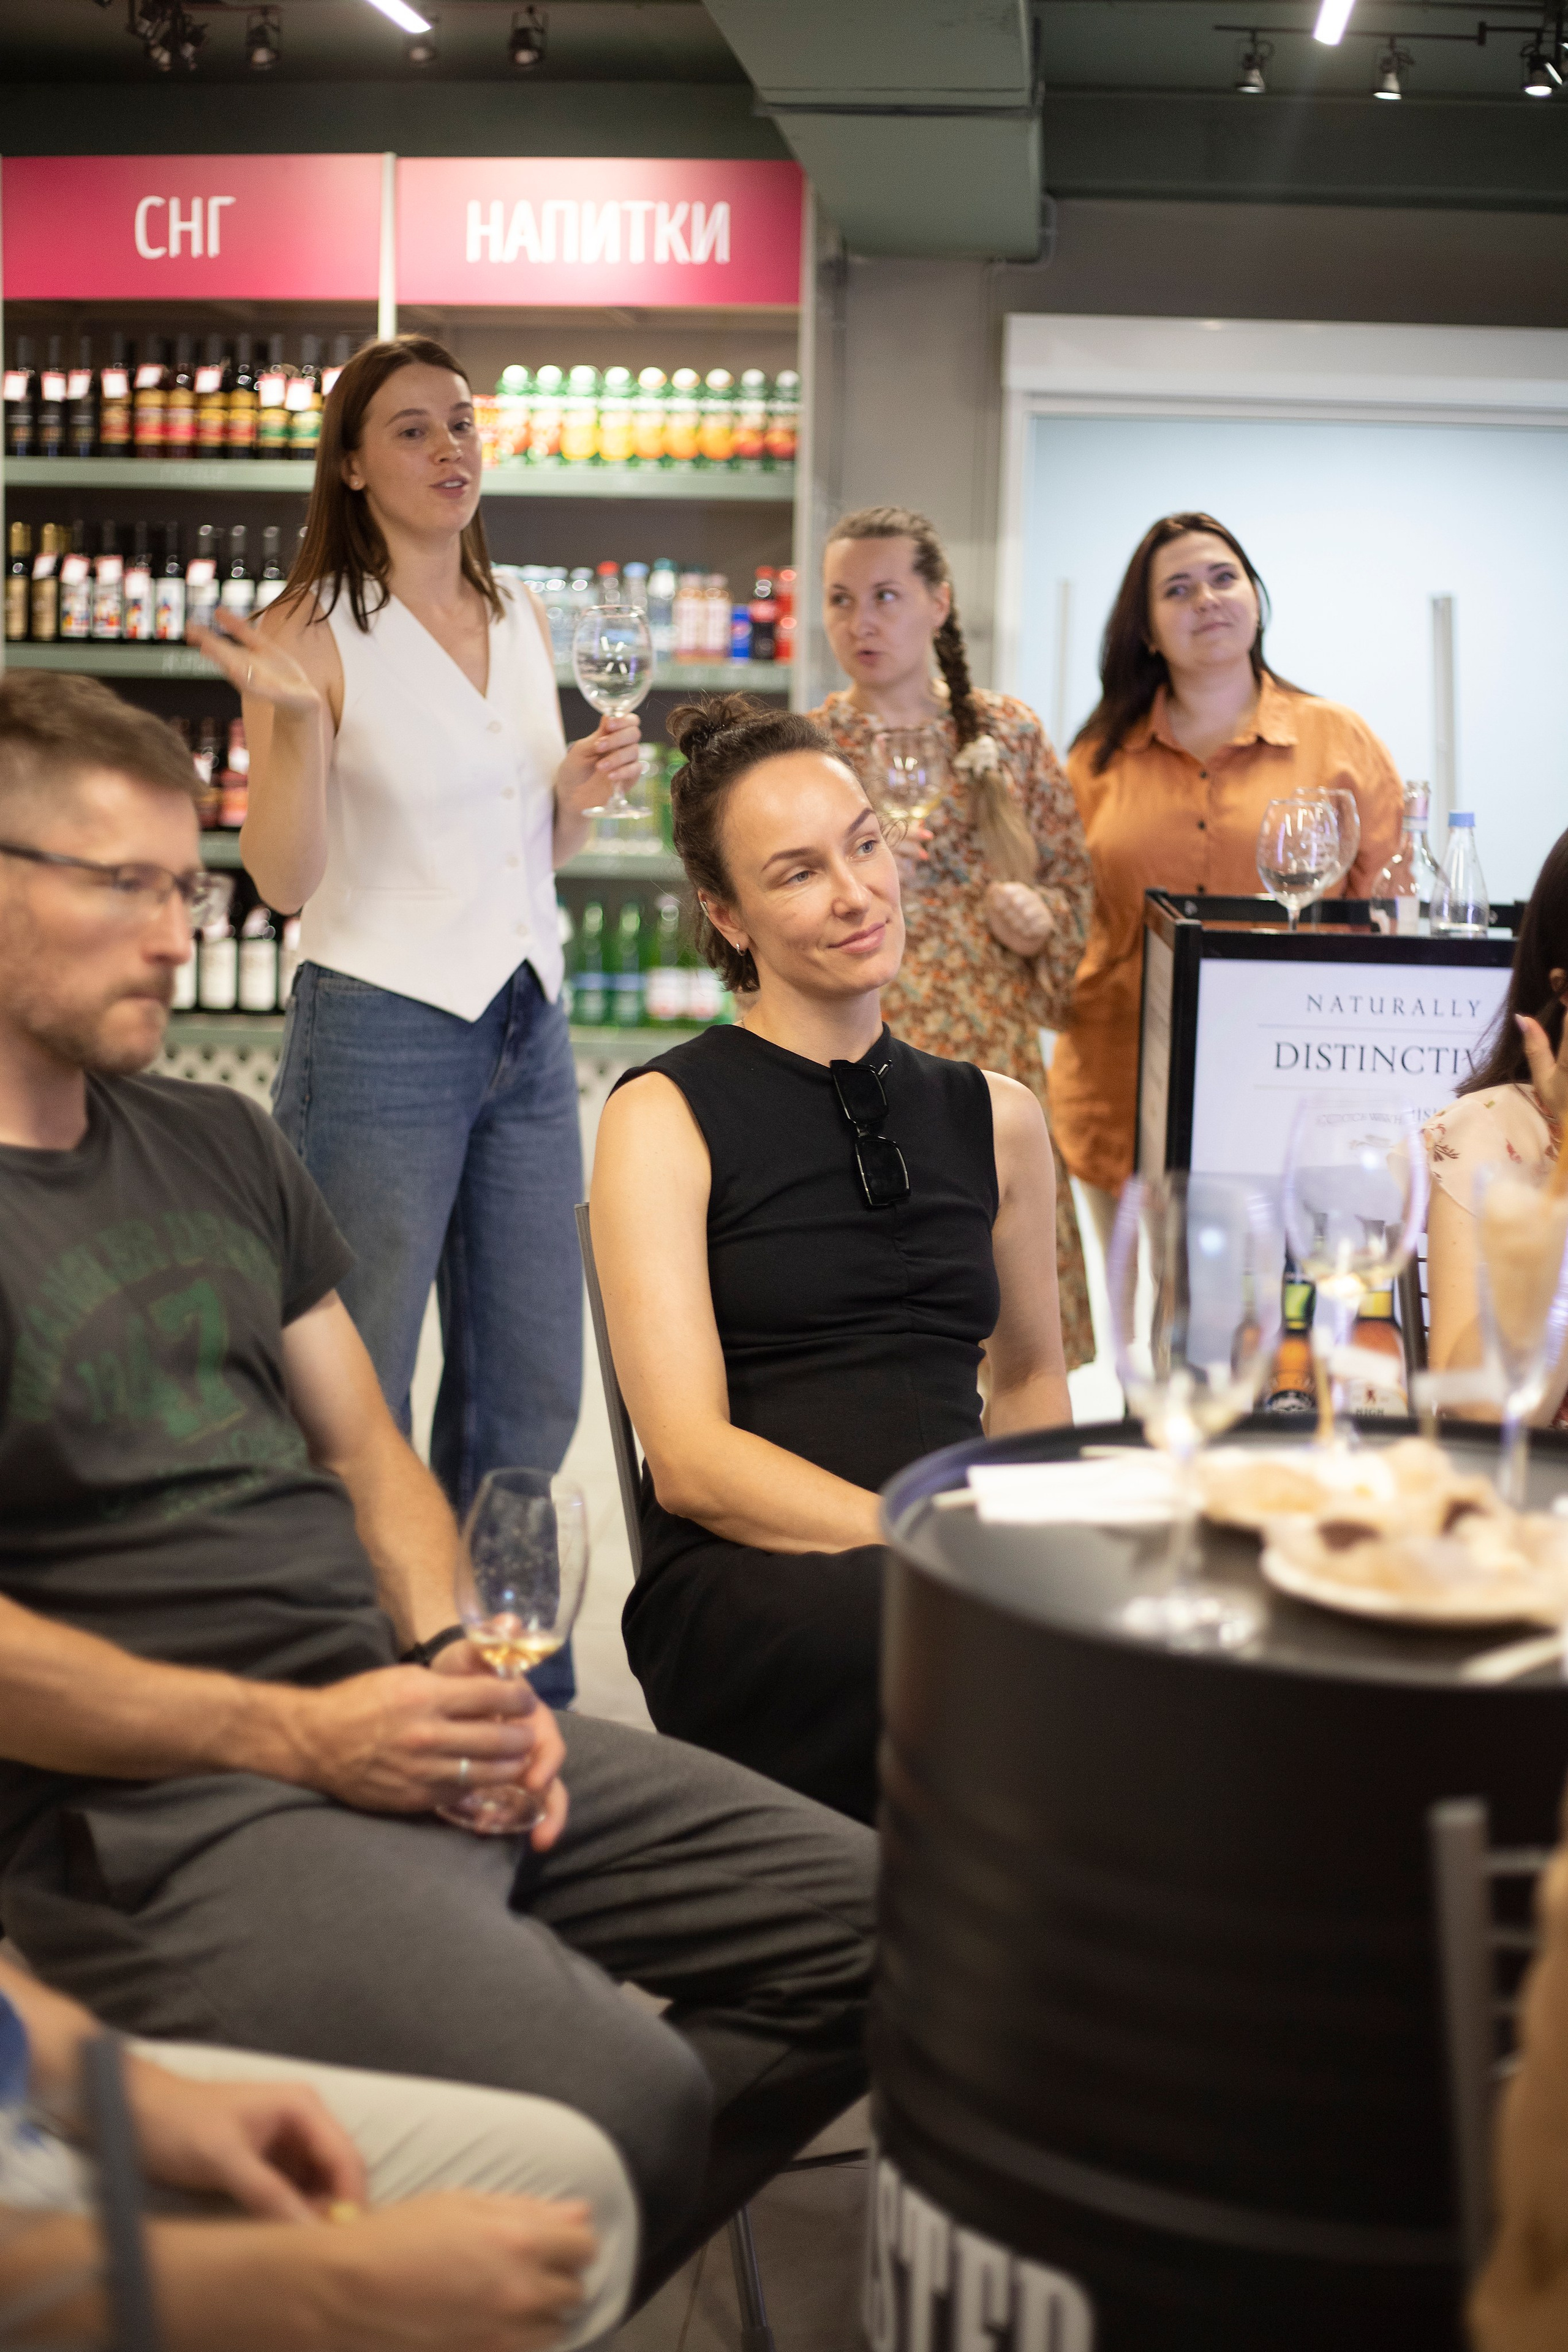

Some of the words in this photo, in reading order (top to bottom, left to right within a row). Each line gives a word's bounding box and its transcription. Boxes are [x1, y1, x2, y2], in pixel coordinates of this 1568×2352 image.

[135, 195, 236, 259] СНГ
[466, 199, 731, 263] НАПИТКИ
[1306, 994, 1481, 1017] NATURALLY
[1274, 1042, 1490, 1075] DISTINCTIV
